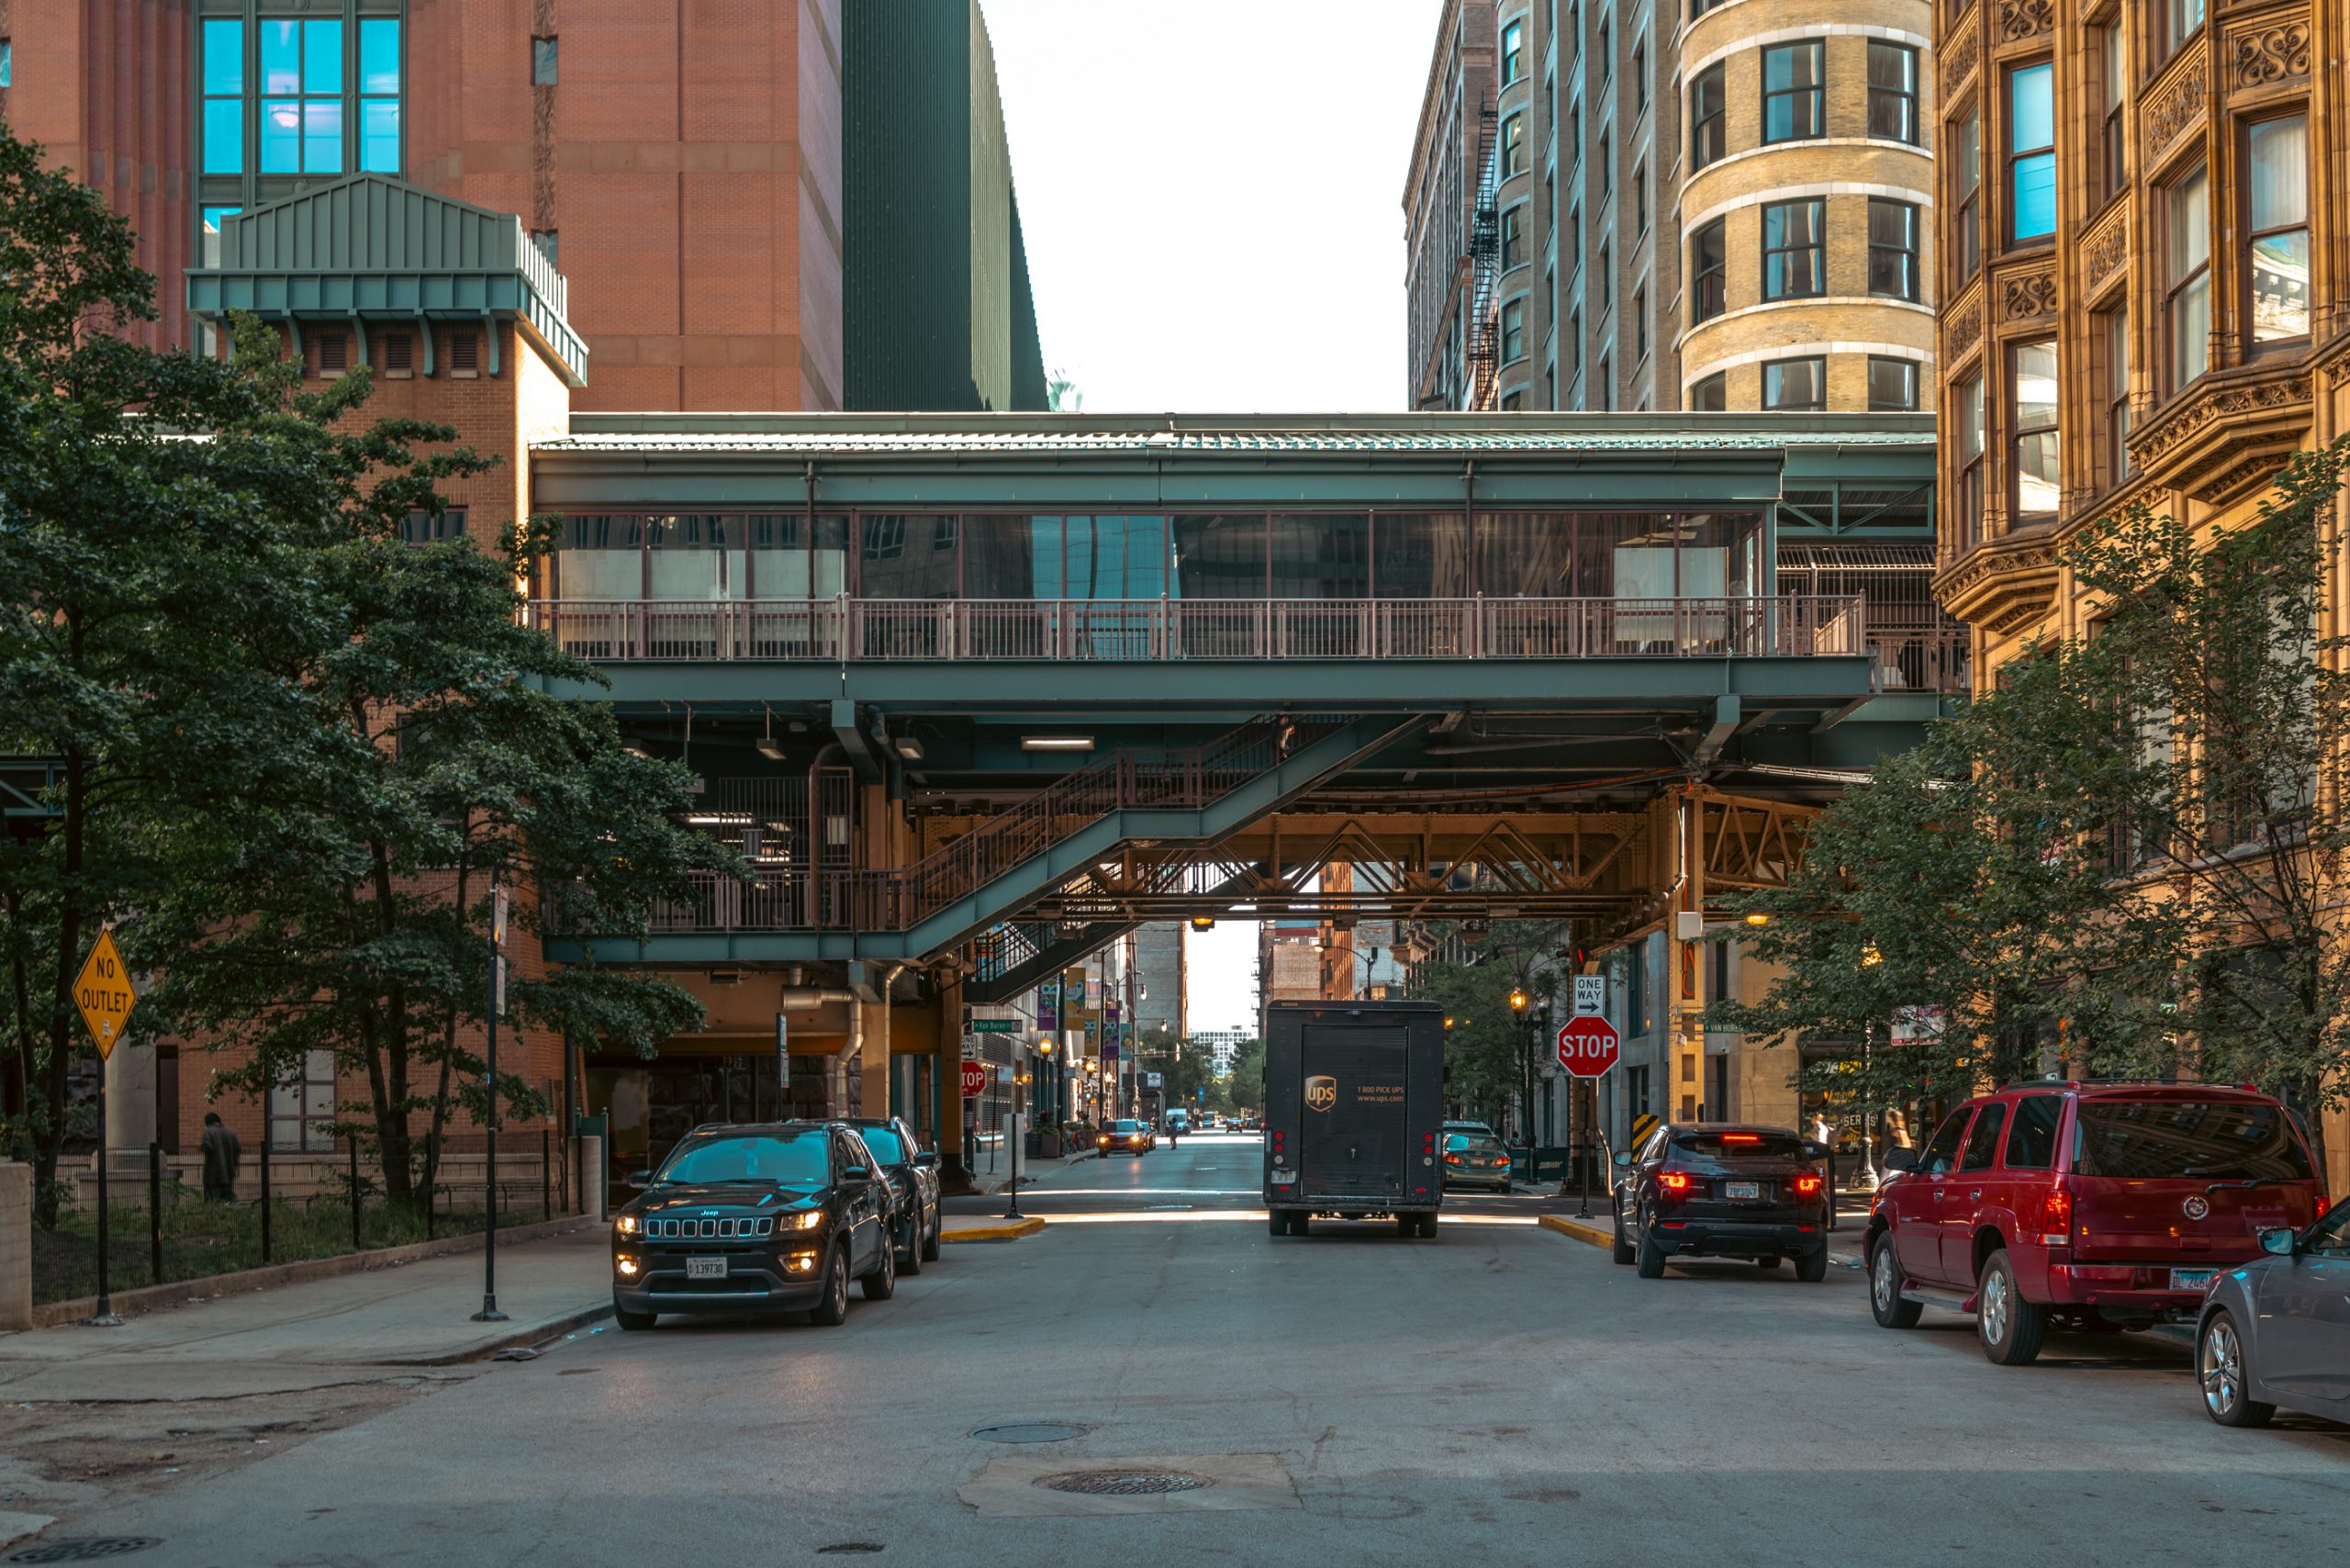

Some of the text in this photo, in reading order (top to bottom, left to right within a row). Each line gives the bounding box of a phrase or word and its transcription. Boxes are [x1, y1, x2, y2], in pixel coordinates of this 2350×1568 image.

[96, 957, 115, 979] NO
[1578, 979, 1601, 989] ONE
[82, 989, 128, 1013] OUTLET
[1577, 990, 1602, 1000] WAY
[1710, 1024, 1722, 1032] VAN
[1561, 1035, 1616, 1058] STOP
[962, 1072, 984, 1087] TOP
[1307, 1087, 1335, 1105] ups
[695, 1263, 723, 1274] 139730
